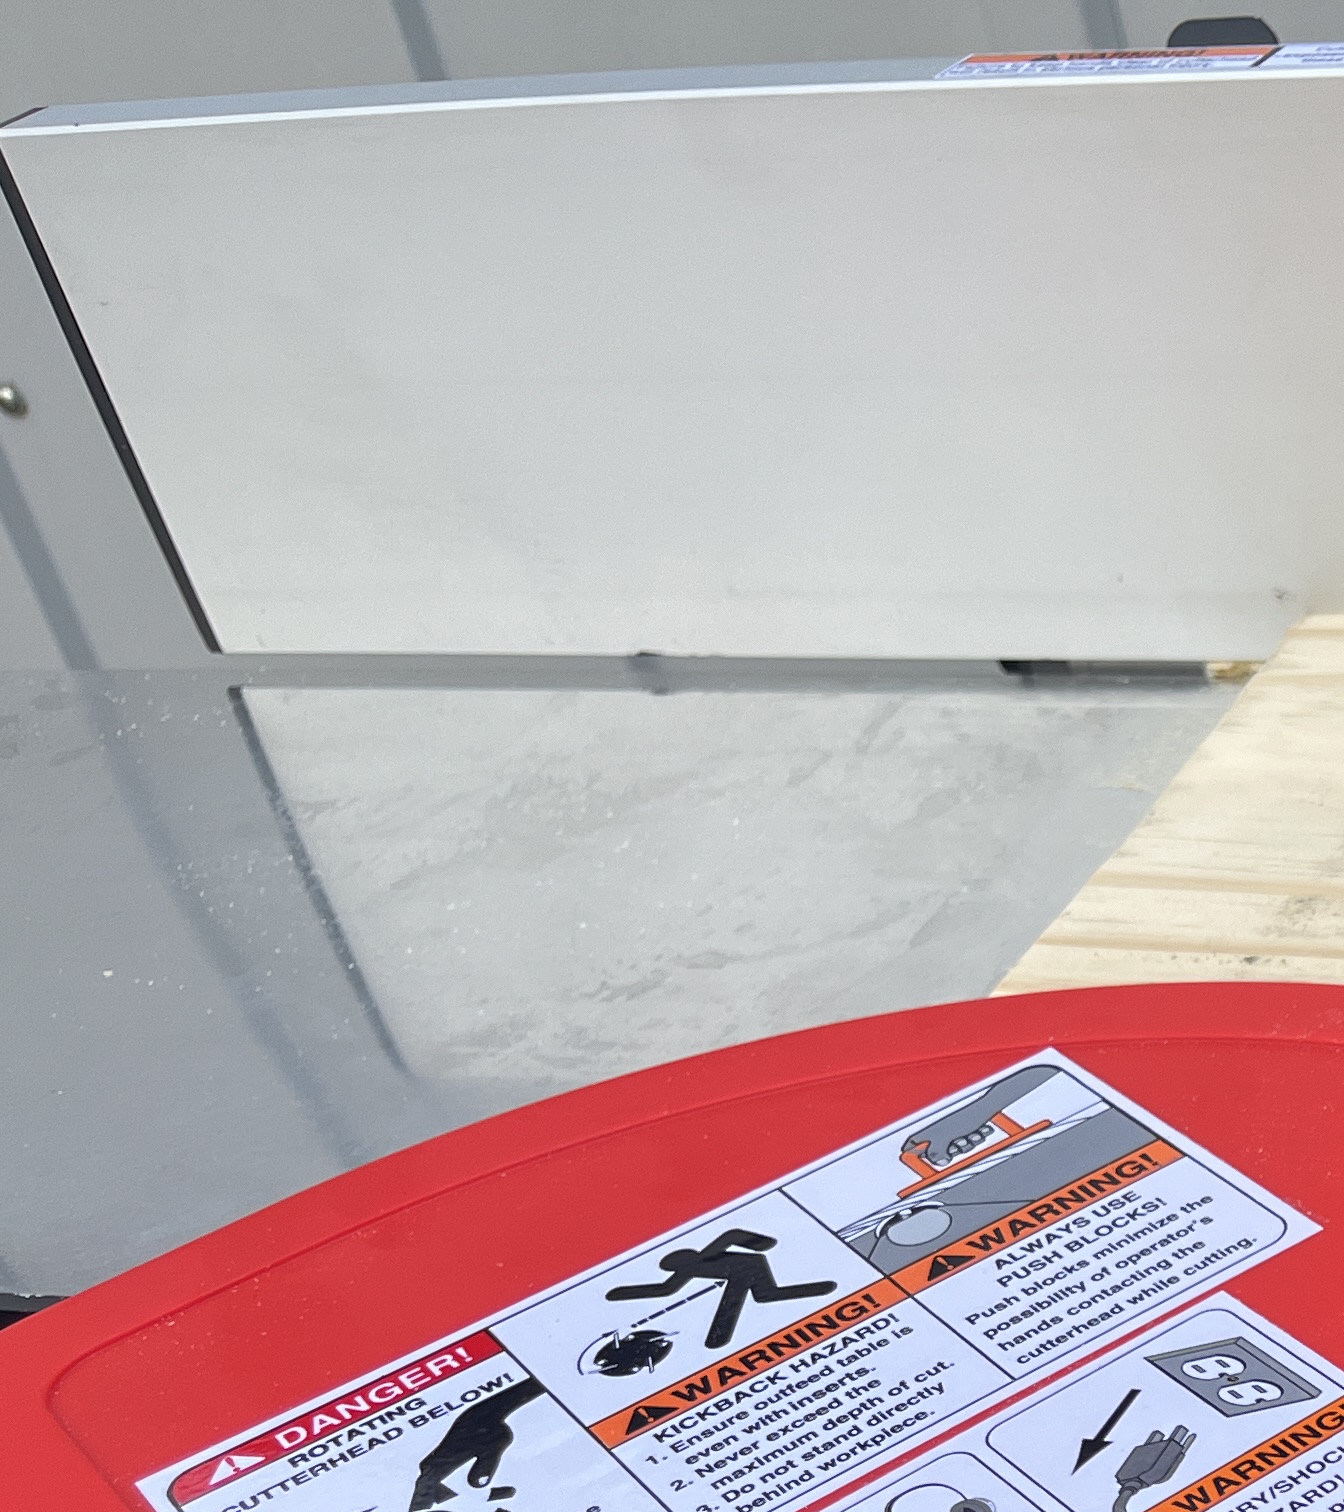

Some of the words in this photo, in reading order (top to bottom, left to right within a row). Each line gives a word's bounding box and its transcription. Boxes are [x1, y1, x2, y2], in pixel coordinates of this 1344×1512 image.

[965, 1152, 1159, 1252] WARNING!
[994, 1216, 1091, 1270] ALWAYS
[1090, 1189, 1142, 1217] USE
[995, 1249, 1064, 1288] PUSH
[1063, 1196, 1167, 1253] BLOCKS!
[963, 1295, 1021, 1325] Push
[1019, 1259, 1090, 1296] blocks
[1091, 1212, 1179, 1260] minimize
[1179, 1195, 1213, 1214] the
[982, 1280, 1086, 1340] possibility
[1089, 1265, 1111, 1282] of
[1114, 1216, 1213, 1269] operator's
[996, 1315, 1064, 1351] hands
[1066, 1258, 1173, 1316] contacting
[1170, 1240, 1206, 1259] the
[1015, 1302, 1125, 1364] cutterhead
[1125, 1275, 1180, 1305] while
[1182, 1237, 1257, 1276] cutting.
[273, 1346, 473, 1449] DANGER!
[407, 1372, 514, 1429] BELOW!
[644, 1454, 668, 1464] 1.
[668, 1410, 750, 1453] Ensure
[753, 1364, 835, 1410] outfeed
[835, 1337, 890, 1367] table
[890, 1326, 914, 1339] is
[651, 1370, 788, 1443] KICKBACK
[787, 1312, 900, 1373] HAZARD!
[669, 1292, 881, 1402] WARNING!
[286, 1397, 427, 1468] ROTATING
[669, 1478, 693, 1492] 2.
[693, 1440, 760, 1478] Never
[765, 1396, 843, 1442] exceed
[844, 1378, 881, 1400] the
[684, 1434, 739, 1465] even
[740, 1408, 790, 1434] with
[786, 1366, 876, 1411] inserts.
[709, 1430, 819, 1490] maximum
[821, 1396, 885, 1431] depth
[887, 1379, 910, 1396] of
[913, 1360, 954, 1383] cut.
[720, 1482, 755, 1503] Do
[758, 1459, 798, 1484] not
[800, 1424, 863, 1462] stand
[865, 1381, 944, 1427] directly
[816, 1410, 935, 1471] workpiece.
